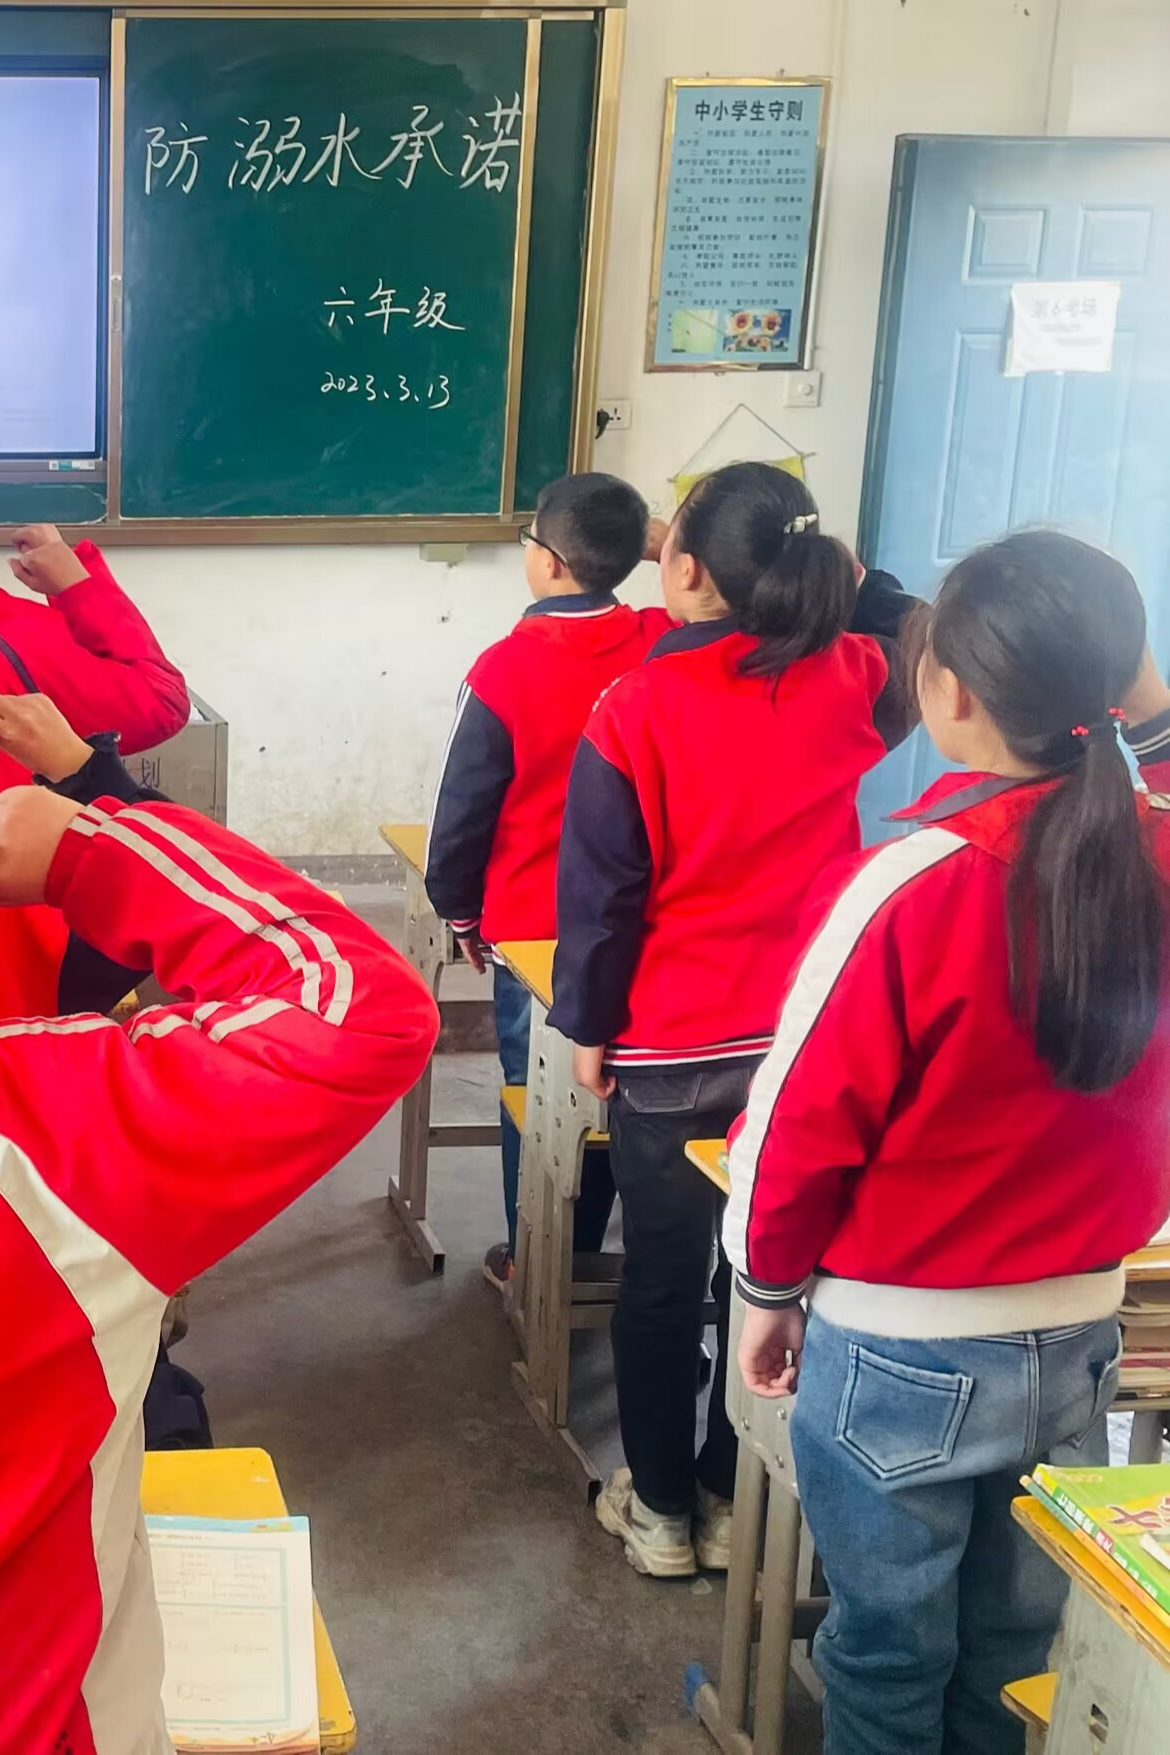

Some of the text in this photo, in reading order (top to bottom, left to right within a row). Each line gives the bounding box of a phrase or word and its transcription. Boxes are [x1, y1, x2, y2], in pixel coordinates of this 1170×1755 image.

[694, 99, 804, 121] 中小学生守则
[145, 92, 522, 195] 防溺水承诺
[324, 278, 466, 334] 六年级
